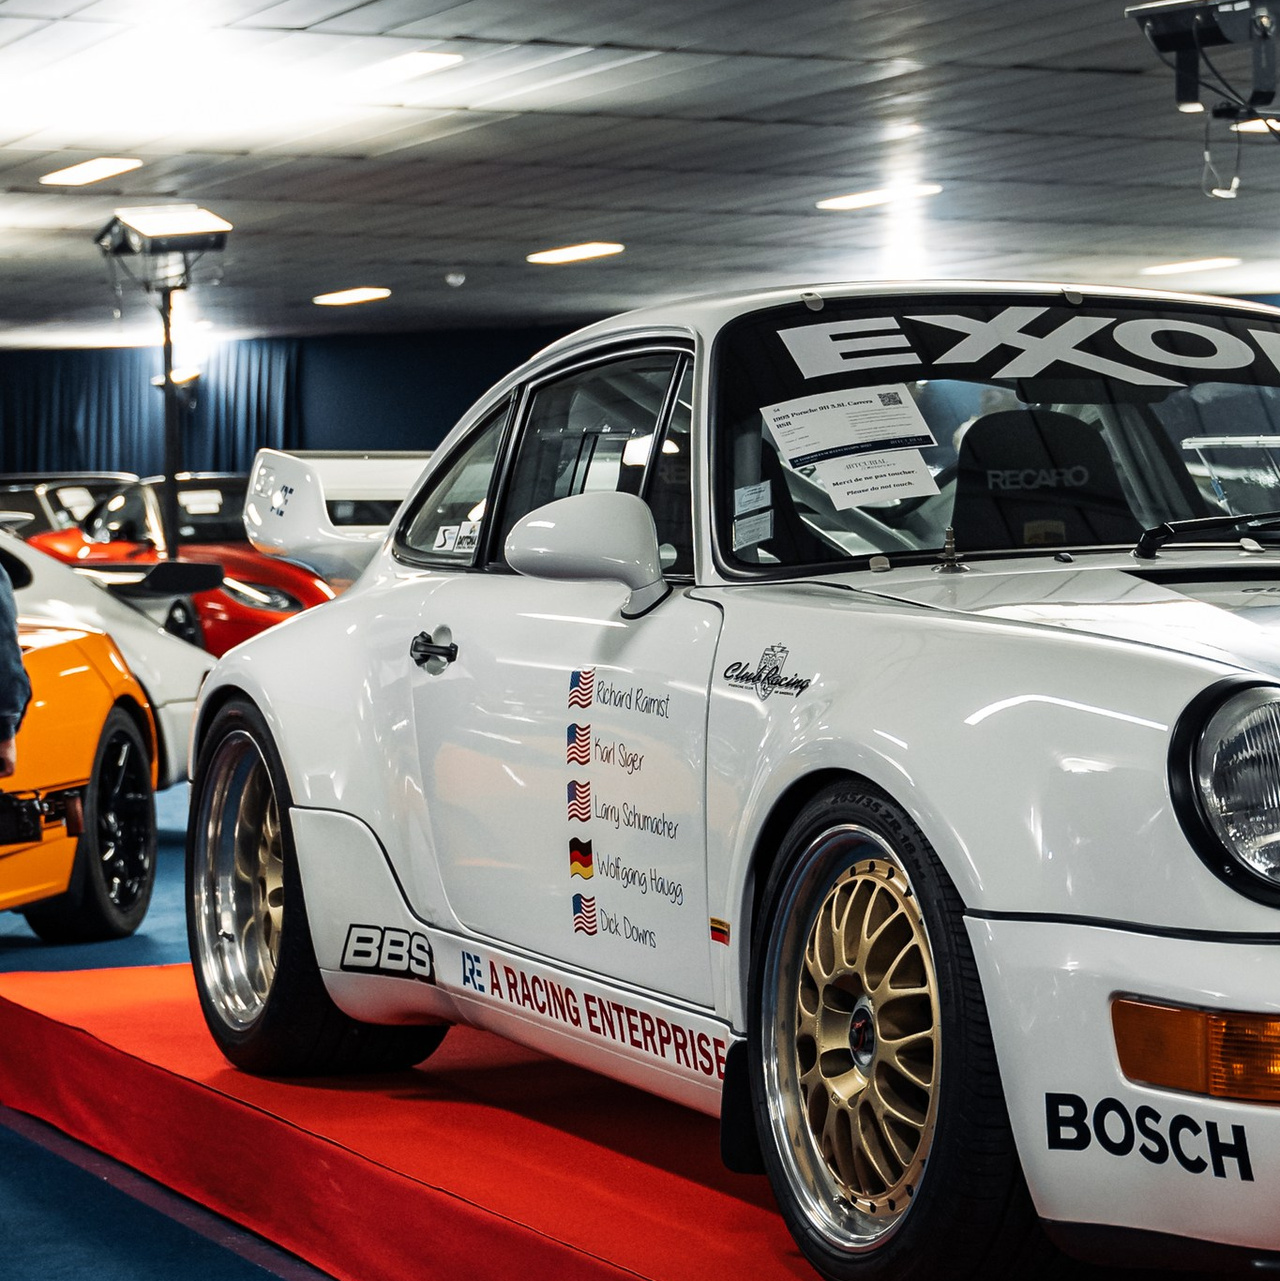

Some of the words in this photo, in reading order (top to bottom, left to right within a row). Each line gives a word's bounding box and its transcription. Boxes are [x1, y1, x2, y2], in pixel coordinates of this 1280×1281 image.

[847, 399, 873, 407] Carrera
[832, 478, 853, 488] Merci
[853, 475, 863, 483] de
[874, 472, 887, 480] pas
[847, 487, 869, 496] Please
[987, 465, 1089, 490] RECARO
[596, 680, 632, 710] Richard
[723, 661, 764, 687] Club
[761, 665, 811, 699] Racing
[595, 794, 620, 829] Larry
[623, 802, 679, 840] Schumacher
[596, 853, 648, 894] Wolfgang
[600, 908, 621, 937] Dick
[624, 917, 657, 948] Downs
[342, 925, 434, 980] BBS
[489, 959, 503, 1000] A
[508, 972, 581, 1028] RACING
[584, 993, 725, 1080] ENTERPRISE
[1045, 1093, 1254, 1182] BOSCH
